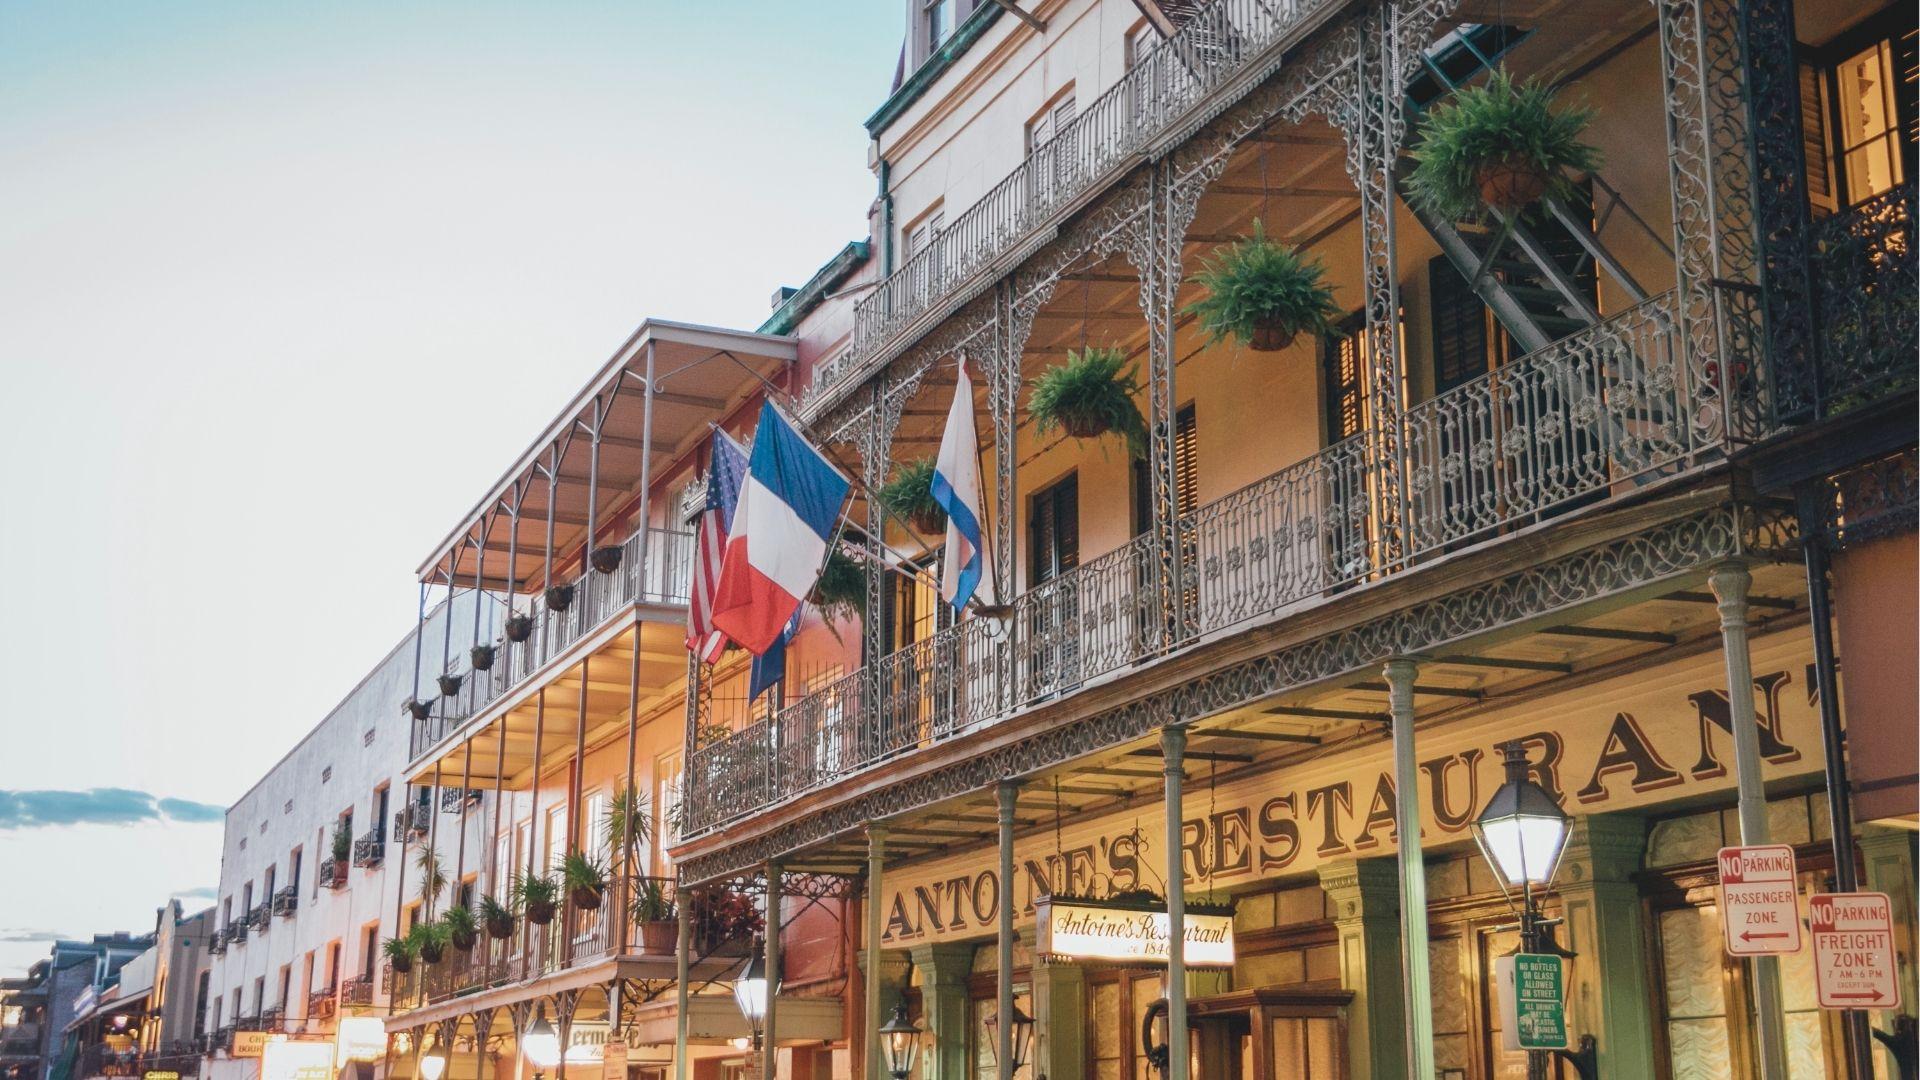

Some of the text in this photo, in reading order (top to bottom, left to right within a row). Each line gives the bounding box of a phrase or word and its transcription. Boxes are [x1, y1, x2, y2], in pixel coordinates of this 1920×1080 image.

[1182, 655, 1847, 885] RESTAURAN
[1721, 856, 1791, 877] NO PARKING
[1727, 891, 1793, 905] PASSENGER
[1745, 911, 1778, 924] ZONE
[1811, 903, 1887, 925] NO PARKING
[1054, 910, 1229, 943] Antoine's Resurant
[1819, 934, 1885, 950] FREIGHT
[1519, 962, 1558, 972] NO BOTTLES
[1833, 953, 1875, 967] ZONE
[1523, 971, 1554, 980] OR GLASS
[1828, 970, 1833, 979] 7
[1524, 980, 1554, 989] ALLOWED
[1522, 989, 1556, 998] ON STREET
